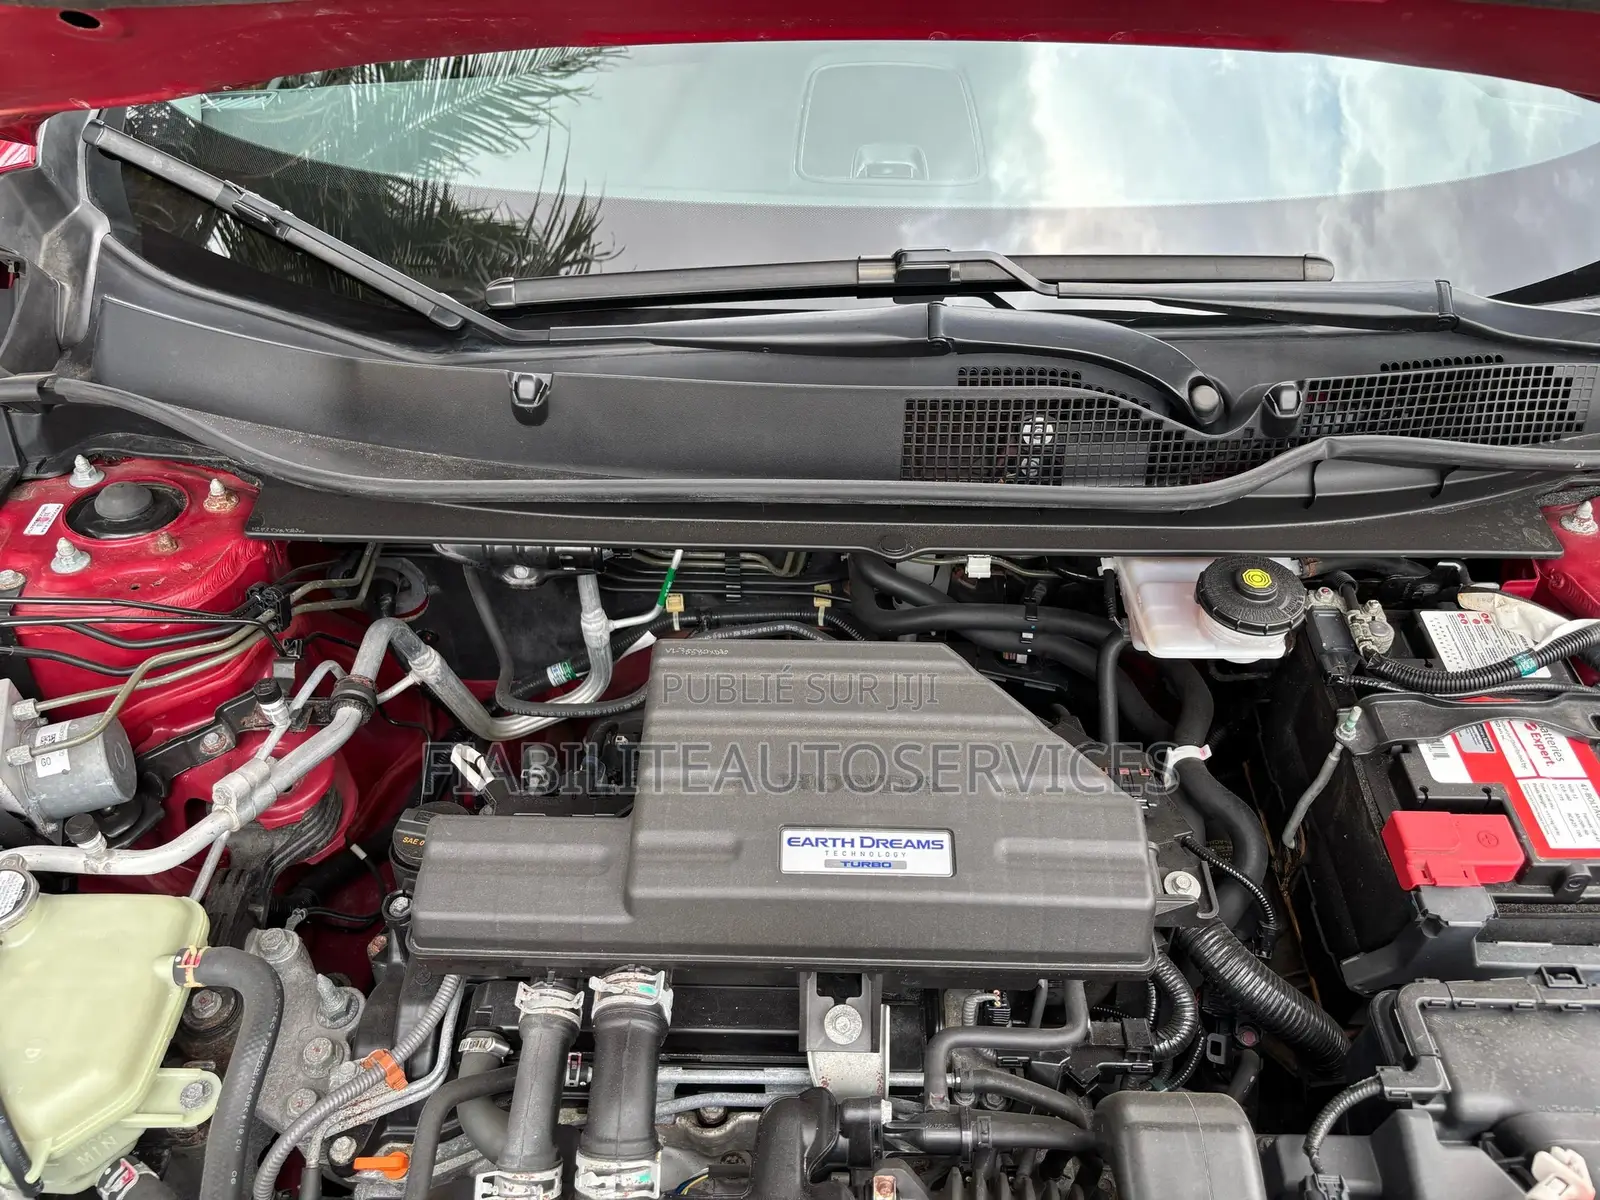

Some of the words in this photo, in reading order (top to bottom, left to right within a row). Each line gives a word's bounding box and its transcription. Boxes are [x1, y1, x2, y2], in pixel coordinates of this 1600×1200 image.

[403, 836, 419, 845] SAE
[787, 836, 855, 848] EARTH
[859, 836, 944, 850] DREAMS
[825, 850, 907, 858] TECHNOLOGY
[840, 860, 892, 868] TURBO
